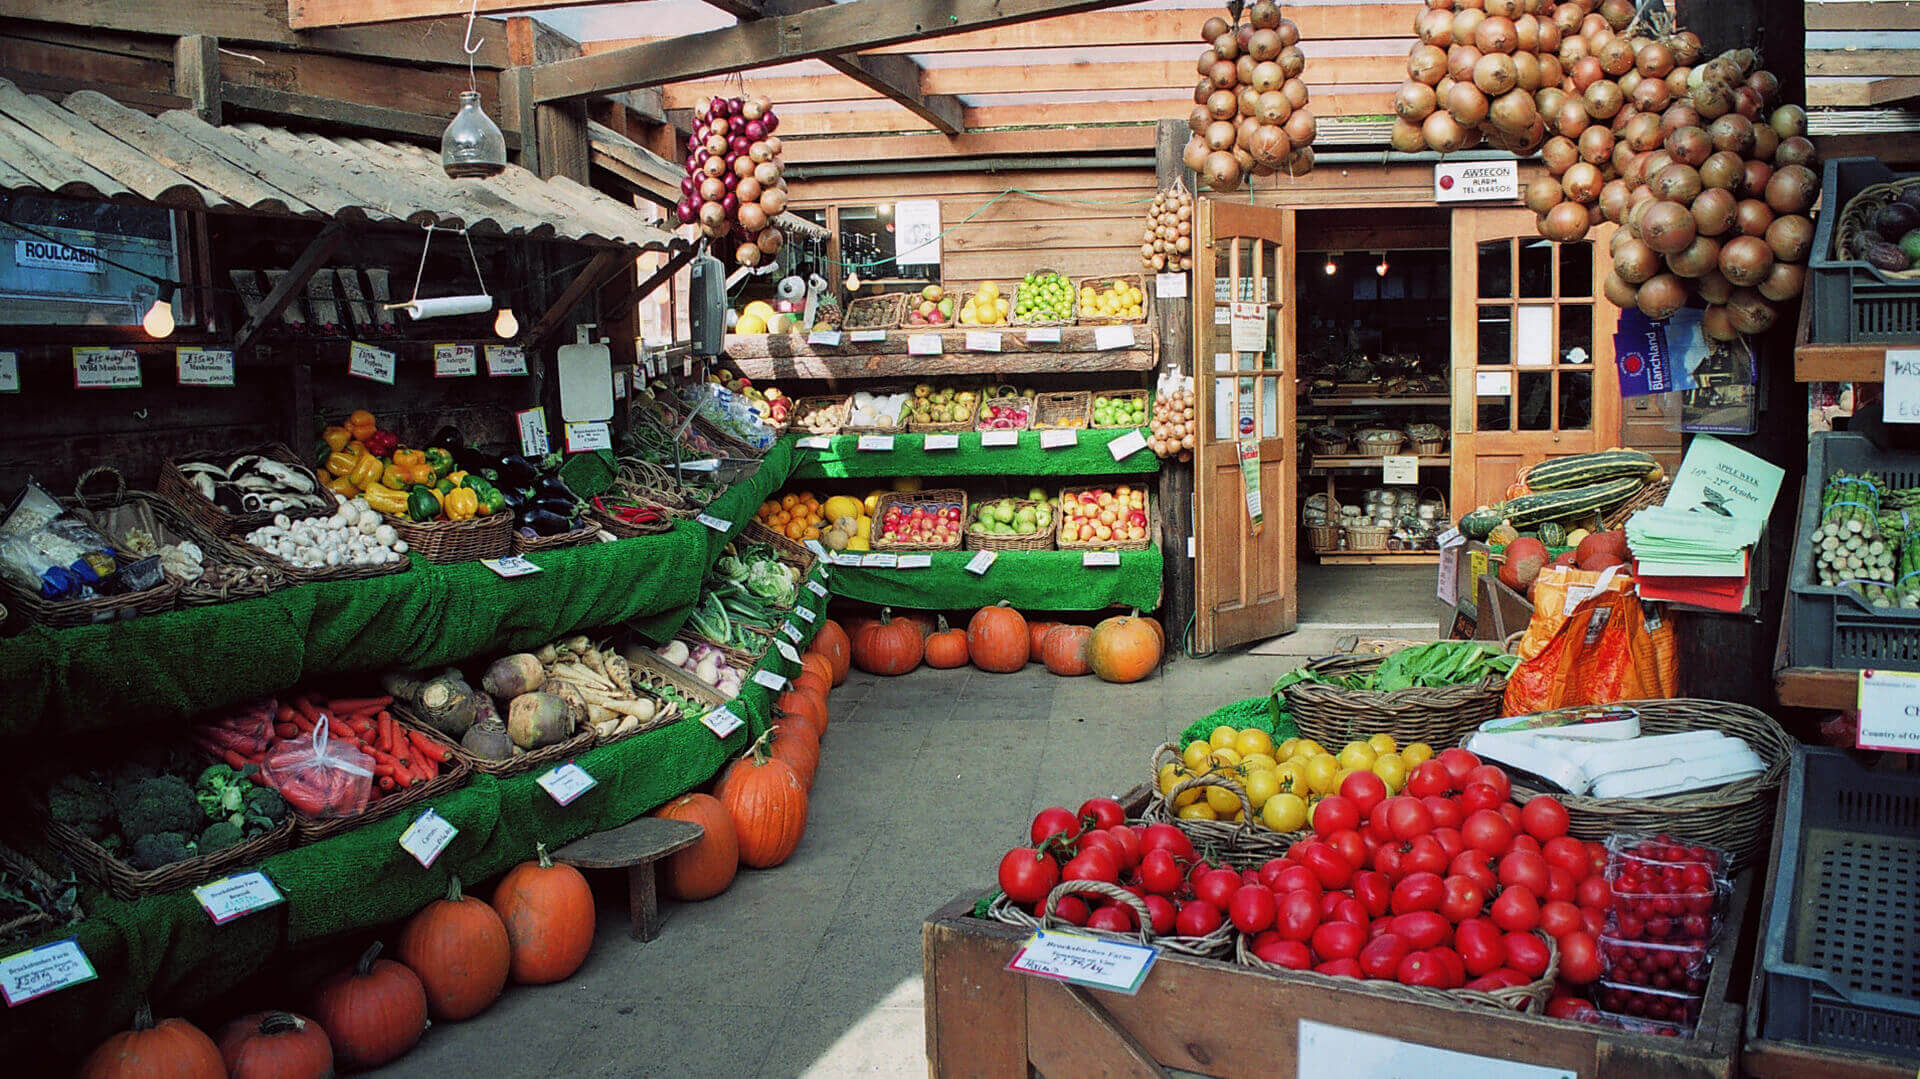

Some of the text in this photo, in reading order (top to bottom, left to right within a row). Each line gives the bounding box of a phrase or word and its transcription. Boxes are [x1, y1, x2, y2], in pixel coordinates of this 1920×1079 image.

[1463, 168, 1510, 177] AWSECON
[1645, 332, 1663, 391] Blanchland
[1718, 463, 1759, 487] APPLE WEEK
[1729, 485, 1759, 503] October
[1862, 729, 1895, 740] Country
[1899, 731, 1907, 740] of
[1107, 951, 1132, 960] Farm
